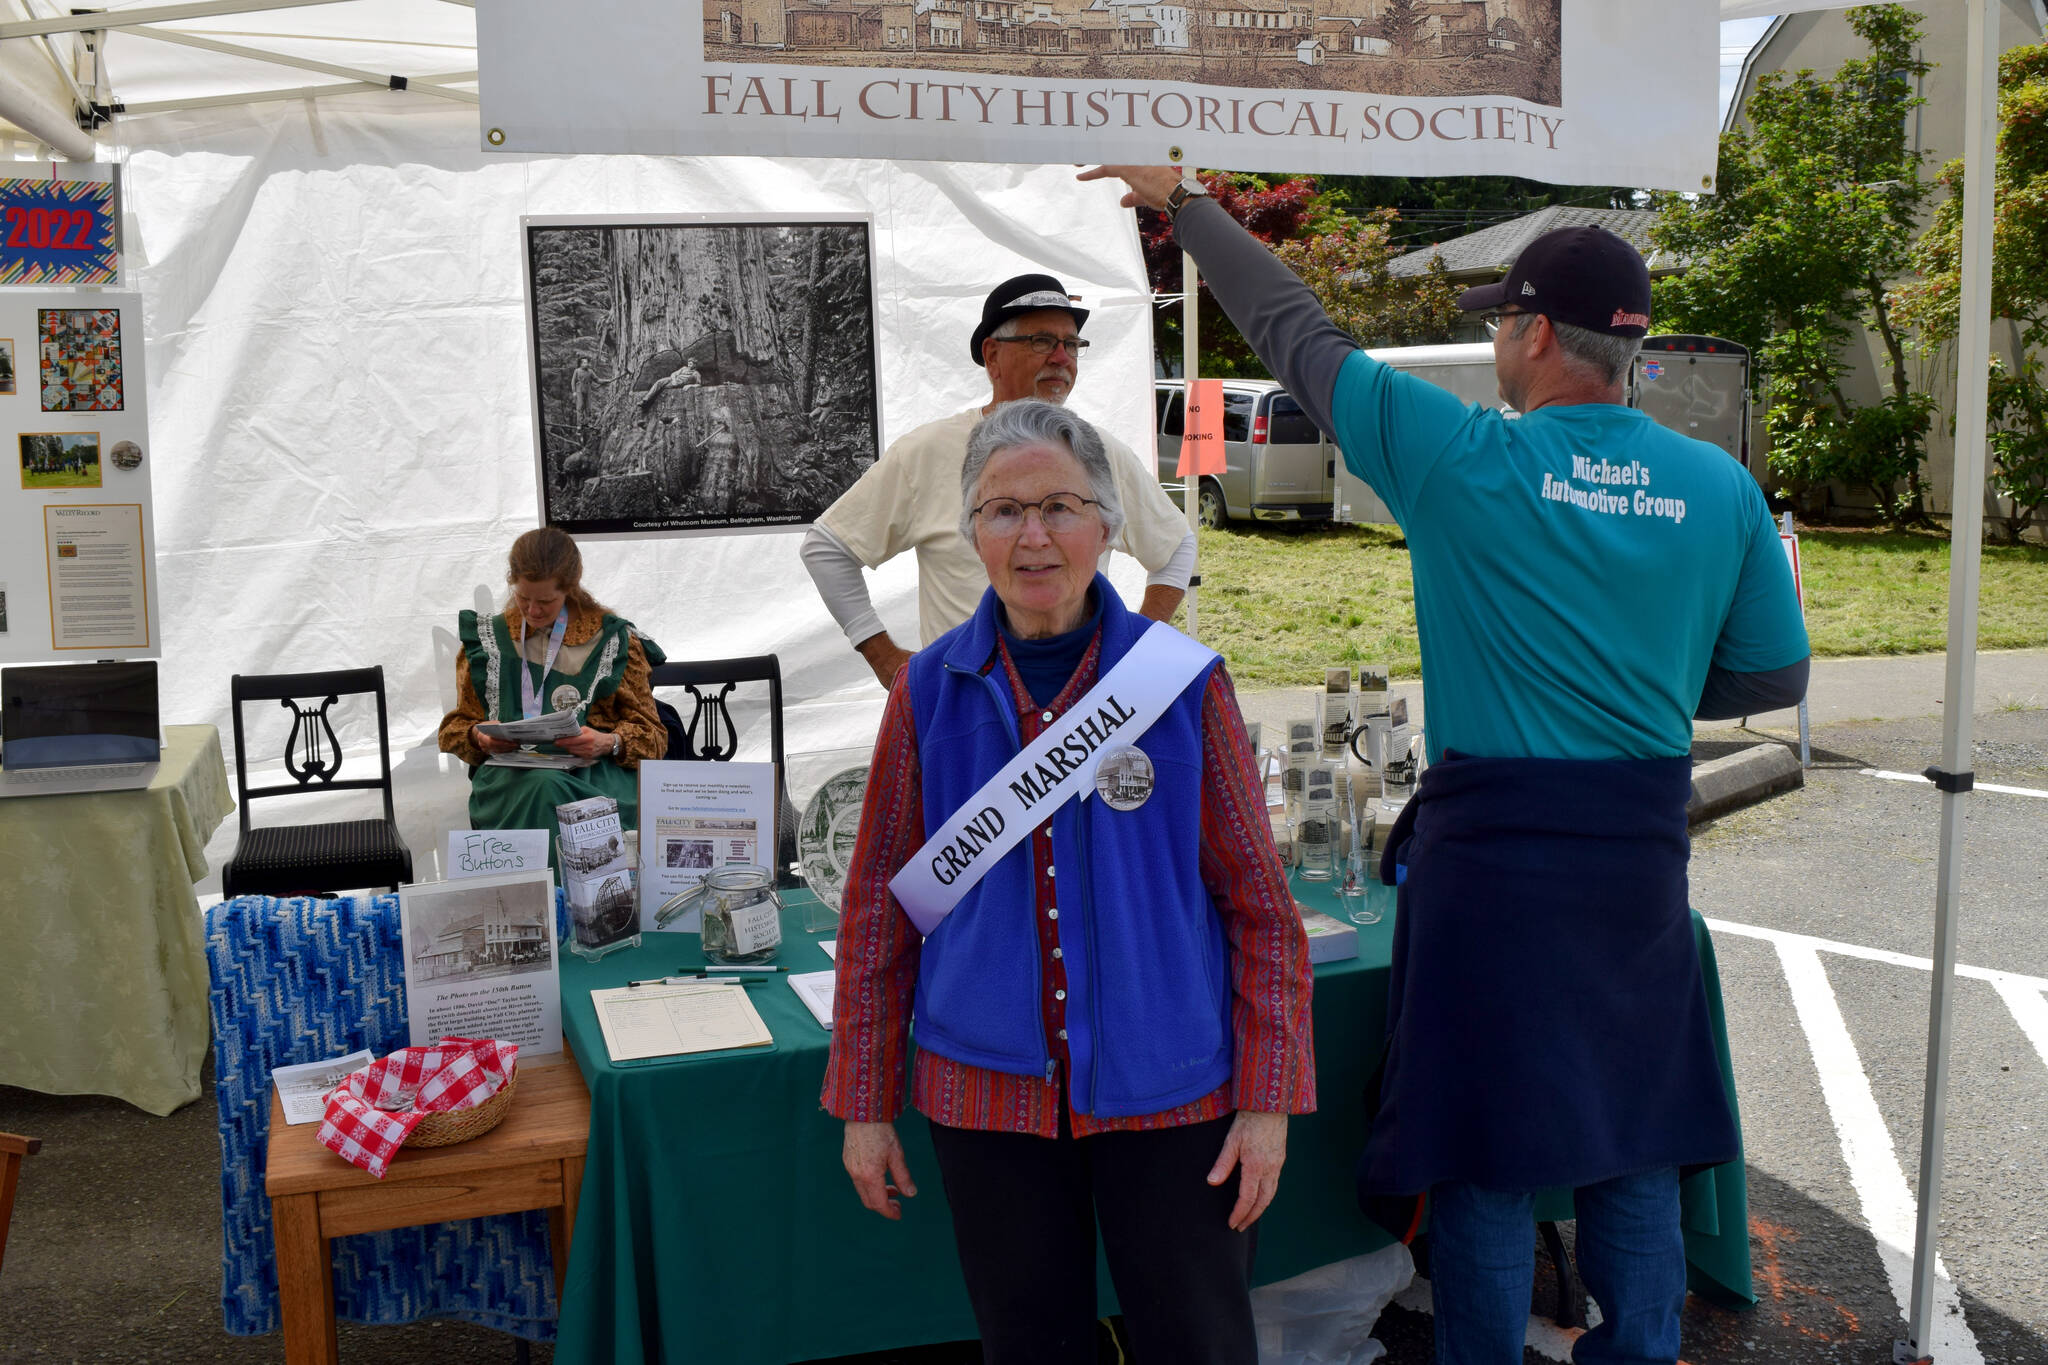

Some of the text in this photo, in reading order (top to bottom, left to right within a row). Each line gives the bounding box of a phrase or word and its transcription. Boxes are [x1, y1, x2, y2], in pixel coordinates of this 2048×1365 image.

[702, 72, 1565, 150] FALL CITY HISTORICAL SOCIETY
[6, 206, 94, 250] 2022
[1572, 454, 1650, 486] Michael's
[1541, 472, 1686, 524] Automotive Group
[932, 695, 1136, 886] GRAND MARSHAL
[574, 816, 617, 835] FALL CITY
[464, 834, 517, 857] Free
[458, 854, 524, 872] Buttons
[450, 992, 469, 1000] Photo
